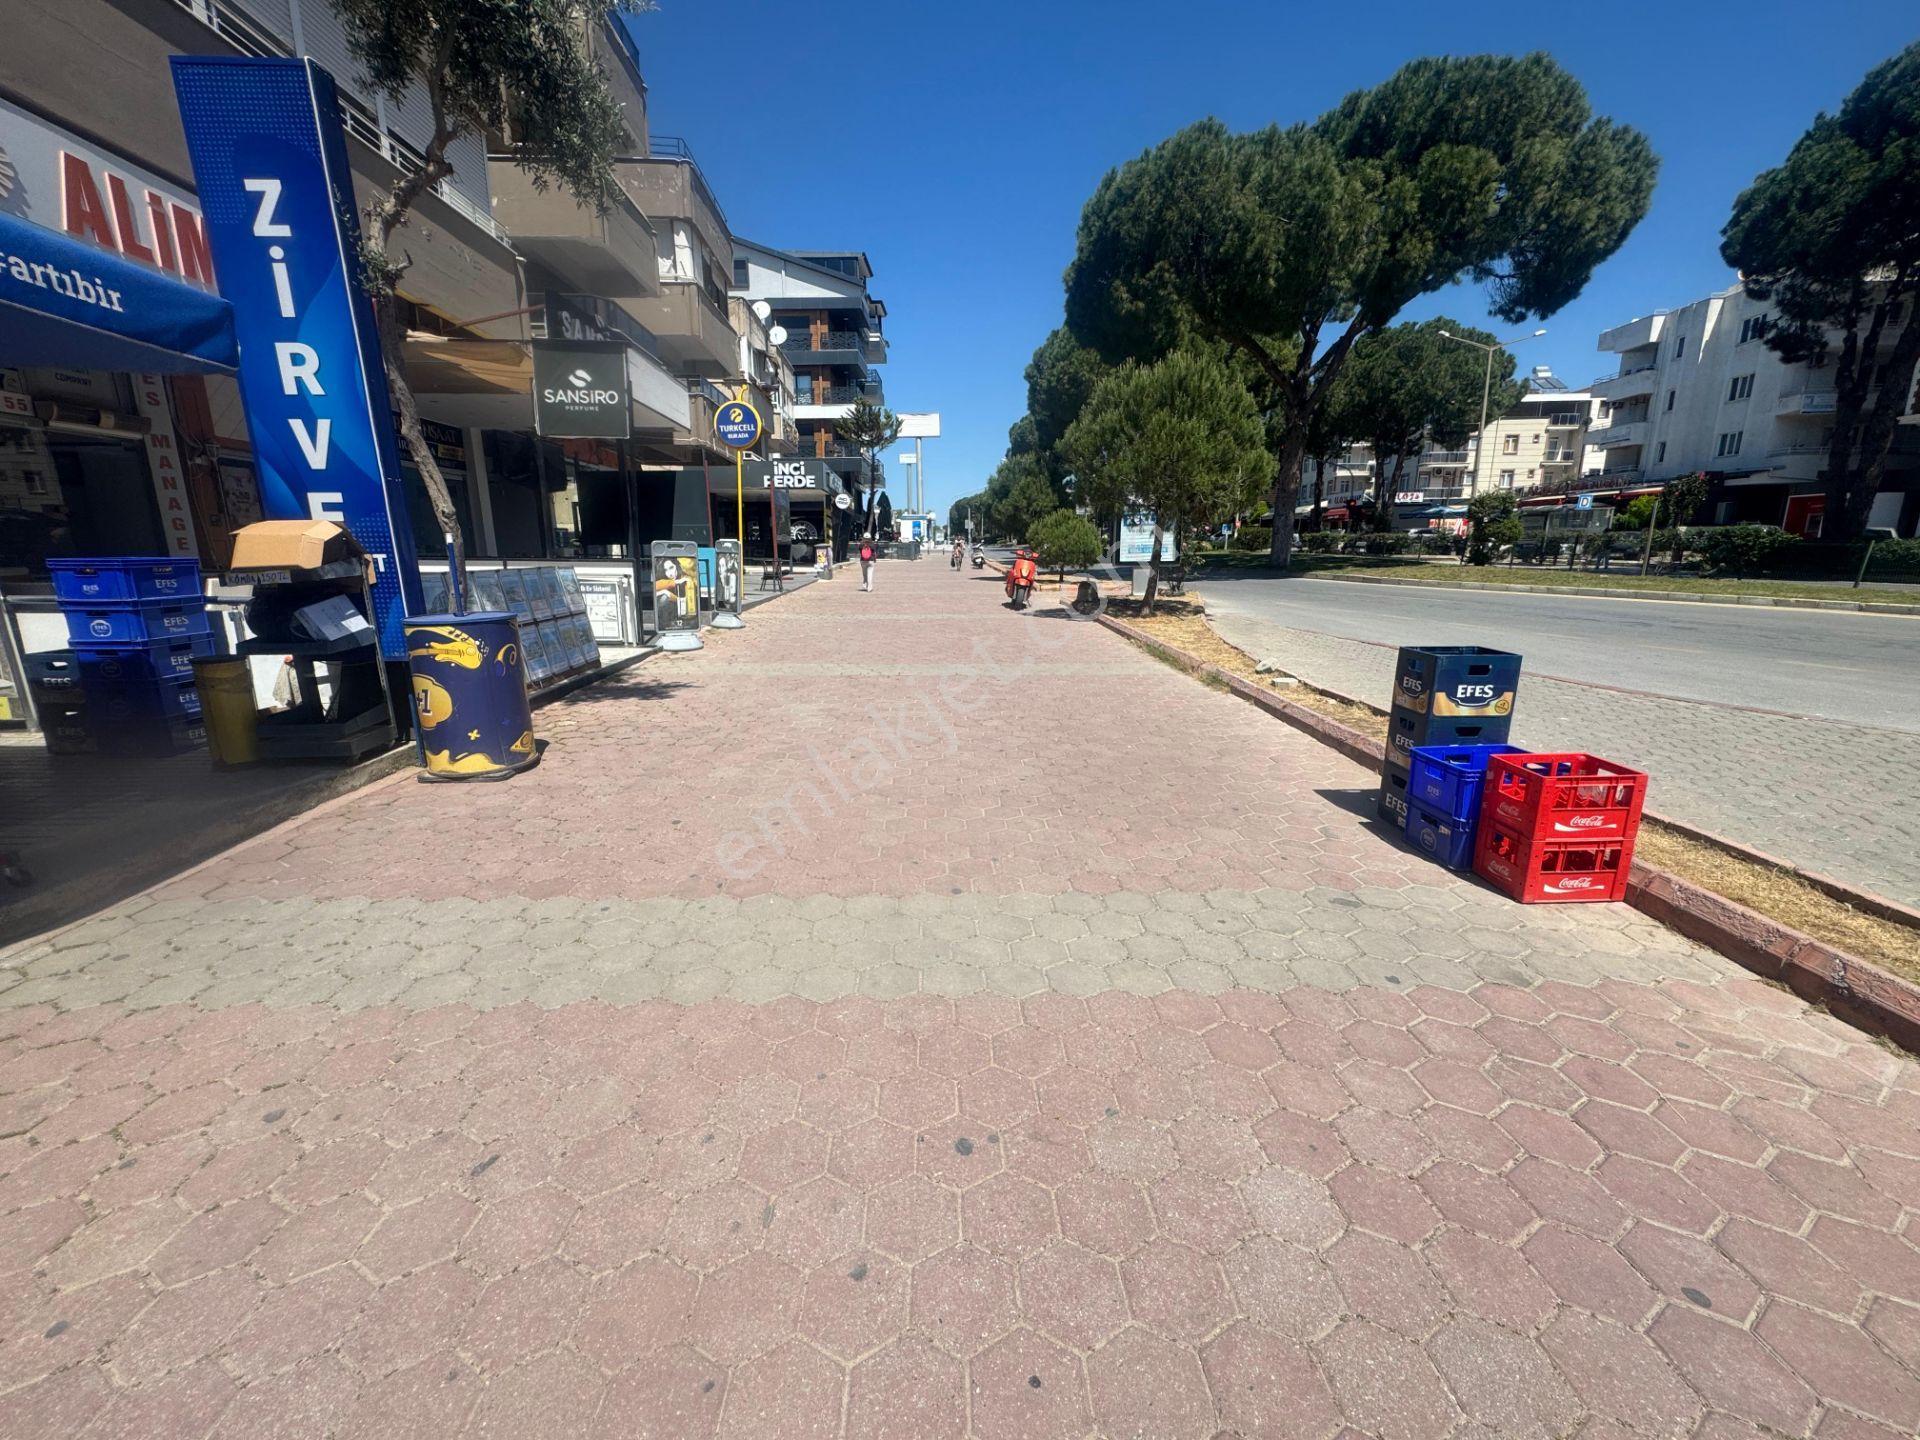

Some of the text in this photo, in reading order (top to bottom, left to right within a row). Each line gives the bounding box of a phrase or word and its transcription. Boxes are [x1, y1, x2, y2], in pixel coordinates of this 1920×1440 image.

[719, 423, 756, 432] TURKCELL
[763, 475, 816, 488] PERDE
[155, 579, 178, 589] EFES
[163, 616, 189, 627] EFES
[43, 677, 73, 688] EFES
[1403, 676, 1423, 692] EFES
[1456, 684, 1494, 698] EFES
[1395, 733, 1415, 748] EFES
[1385, 792, 1408, 816] EFES
